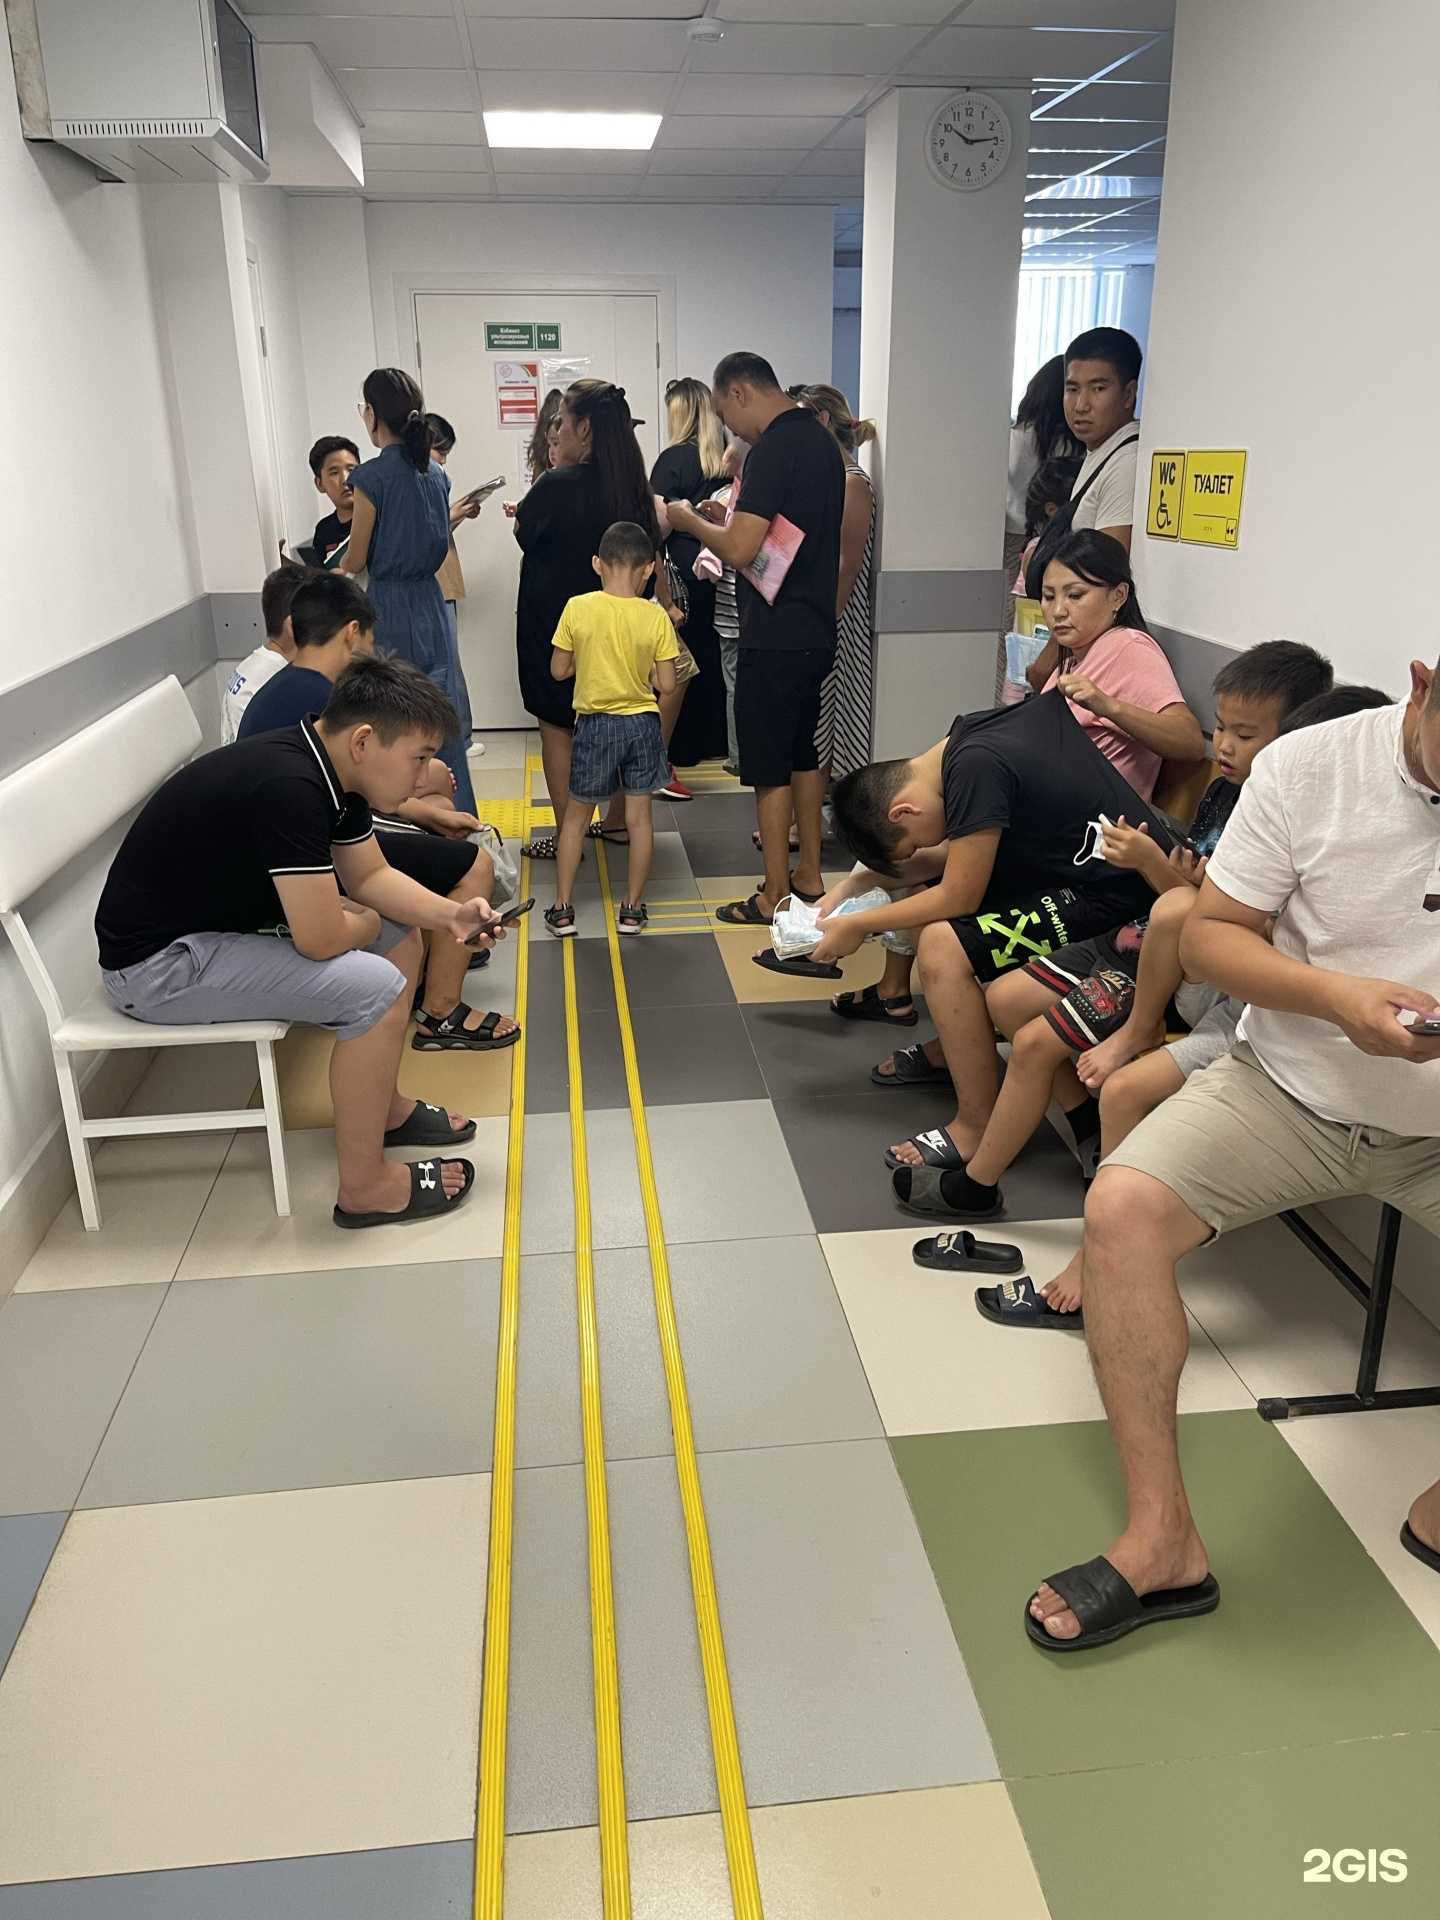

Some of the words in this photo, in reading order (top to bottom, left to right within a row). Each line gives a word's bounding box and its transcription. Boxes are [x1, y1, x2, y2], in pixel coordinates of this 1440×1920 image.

[953, 111, 960, 121] 11
[965, 107, 975, 117] 12
[944, 123, 952, 133] 10
[988, 121, 995, 132] 2
[939, 138, 945, 149] 9
[992, 136, 999, 146] 3
[943, 152, 950, 162] 8
[988, 150, 995, 159] 4
[951, 163, 958, 174] 7
[965, 167, 971, 177] 6
[980, 162, 987, 172] 5
[540, 333, 556, 341] 1120
[1159, 461, 1176, 486] WC
[1194, 474, 1234, 495] ТУАЛЕТ
